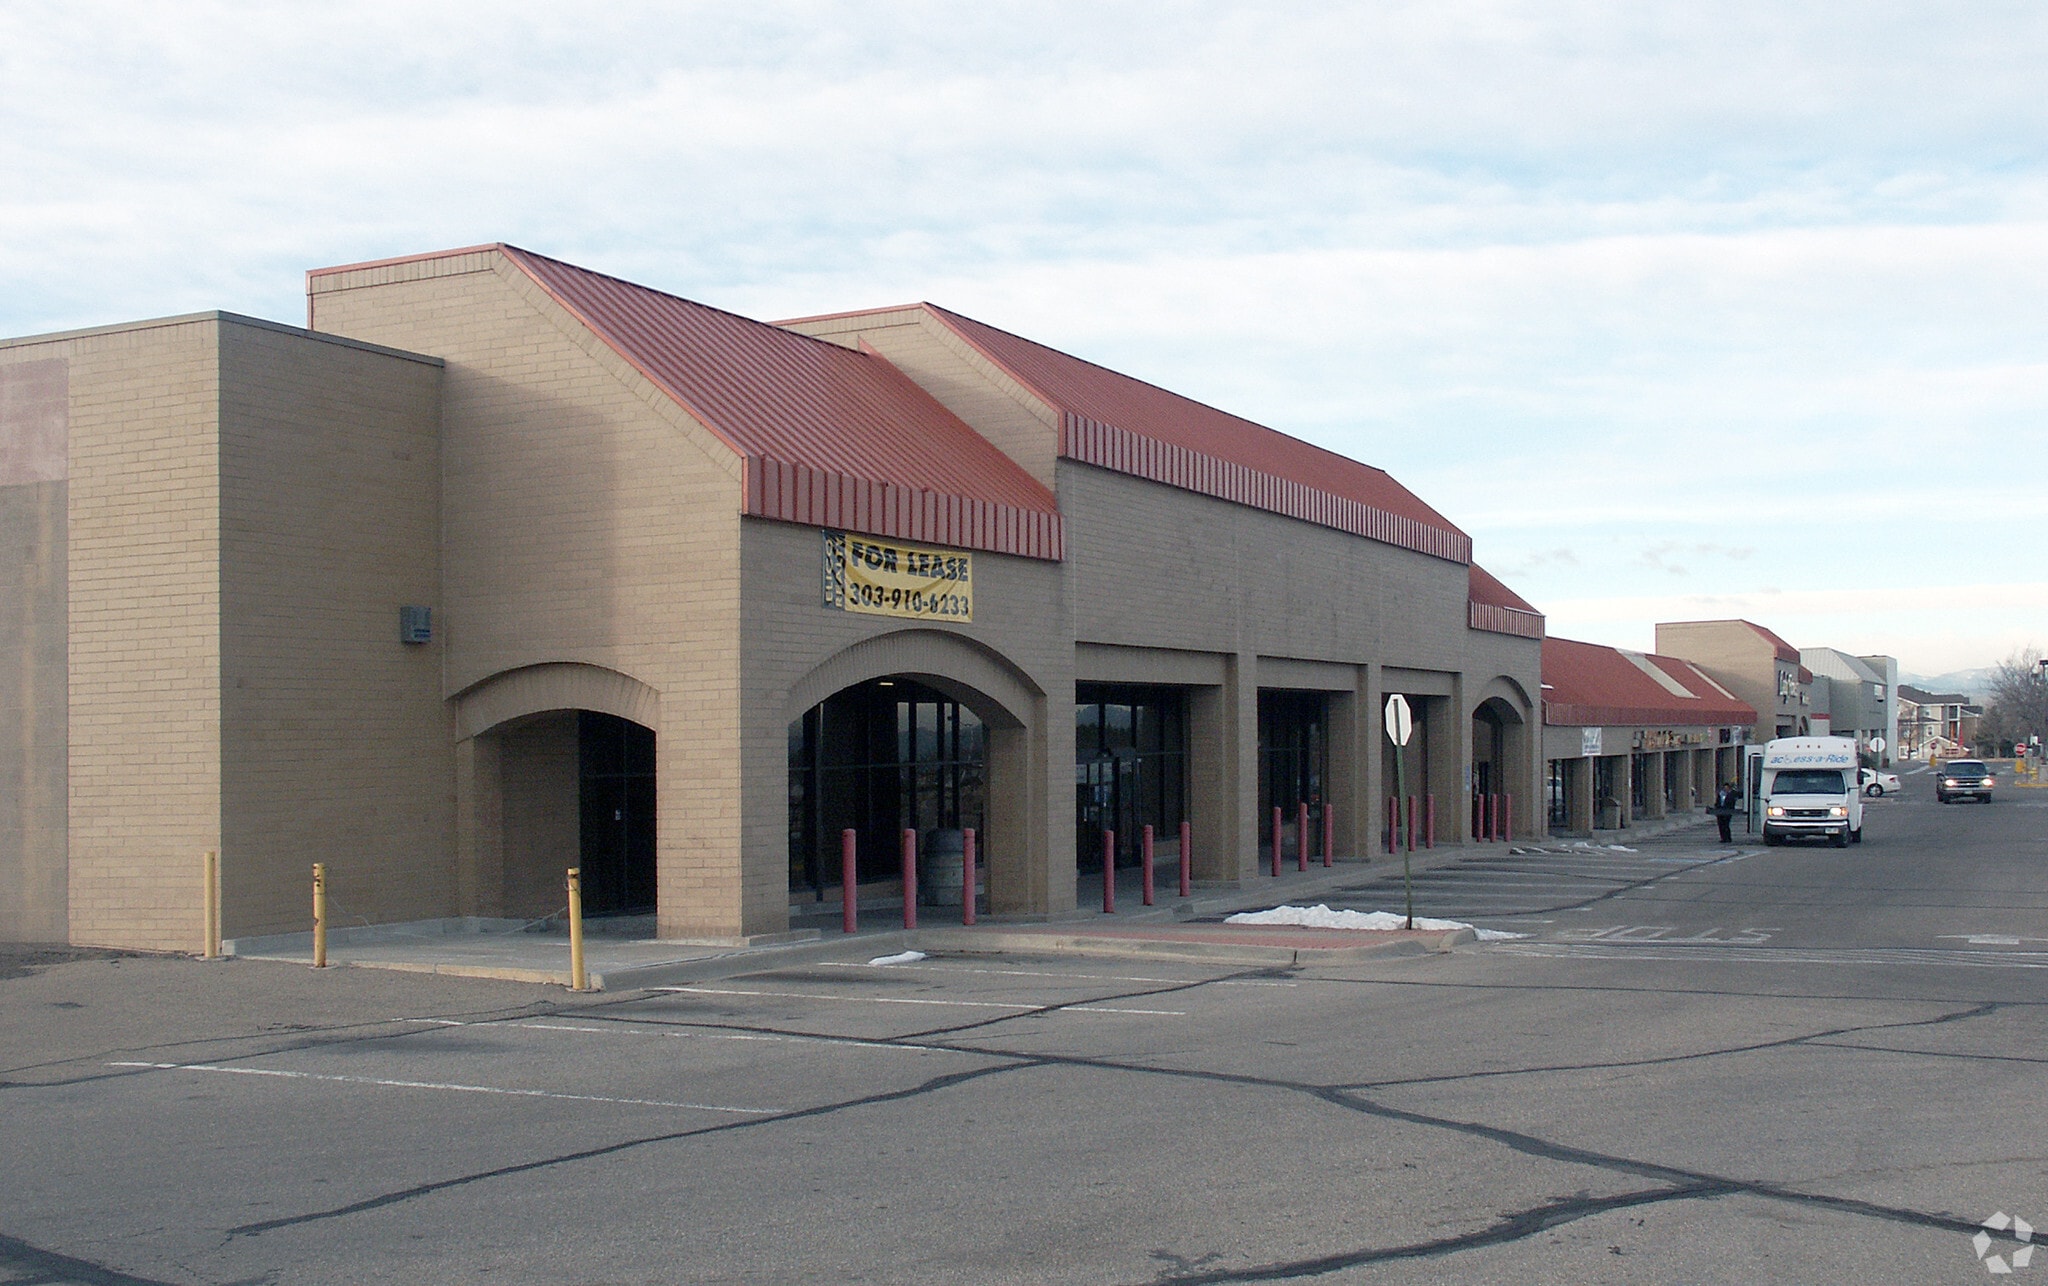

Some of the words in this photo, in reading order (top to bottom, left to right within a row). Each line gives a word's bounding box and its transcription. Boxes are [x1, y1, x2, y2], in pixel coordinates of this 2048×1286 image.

[825, 539, 834, 602] ELICO
[835, 537, 844, 608] REALTY
[851, 541, 898, 573] FOR
[907, 552, 969, 582] LEASE
[850, 583, 969, 617] 303-910-6233
